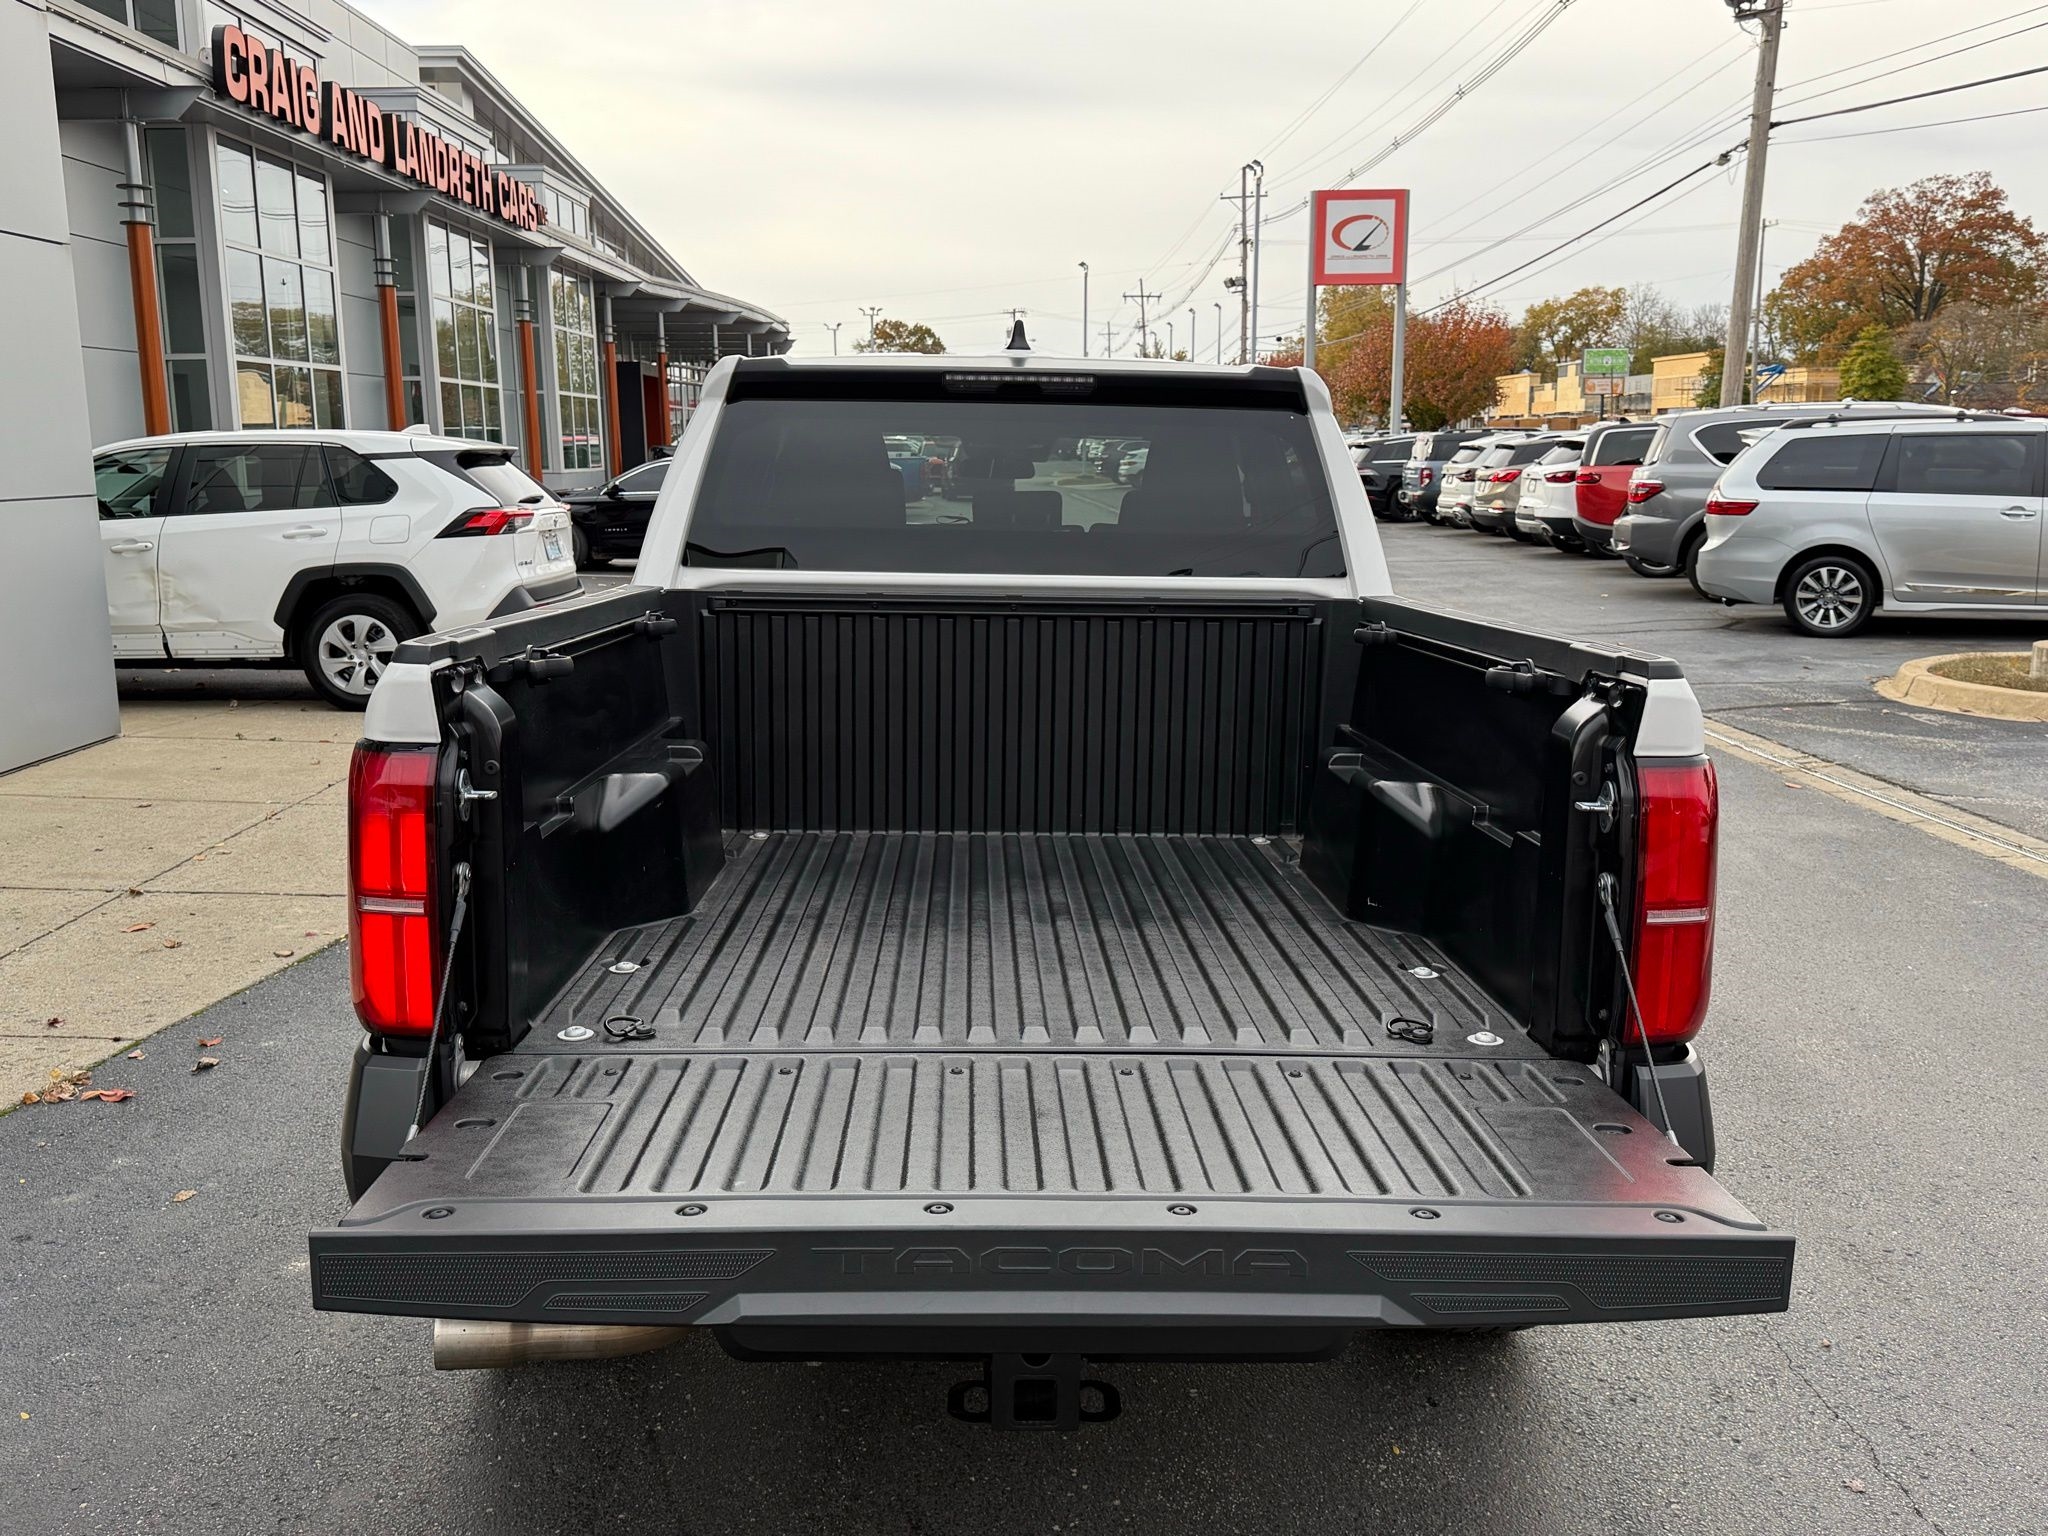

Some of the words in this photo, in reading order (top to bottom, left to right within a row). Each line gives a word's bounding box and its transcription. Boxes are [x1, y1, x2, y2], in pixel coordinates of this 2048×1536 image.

[220, 24, 320, 135] CRAIG
[331, 81, 386, 164] AND
[392, 114, 494, 214] LANDRETH
[497, 170, 538, 232] CARS
[810, 1246, 1309, 1276] TACOMA
